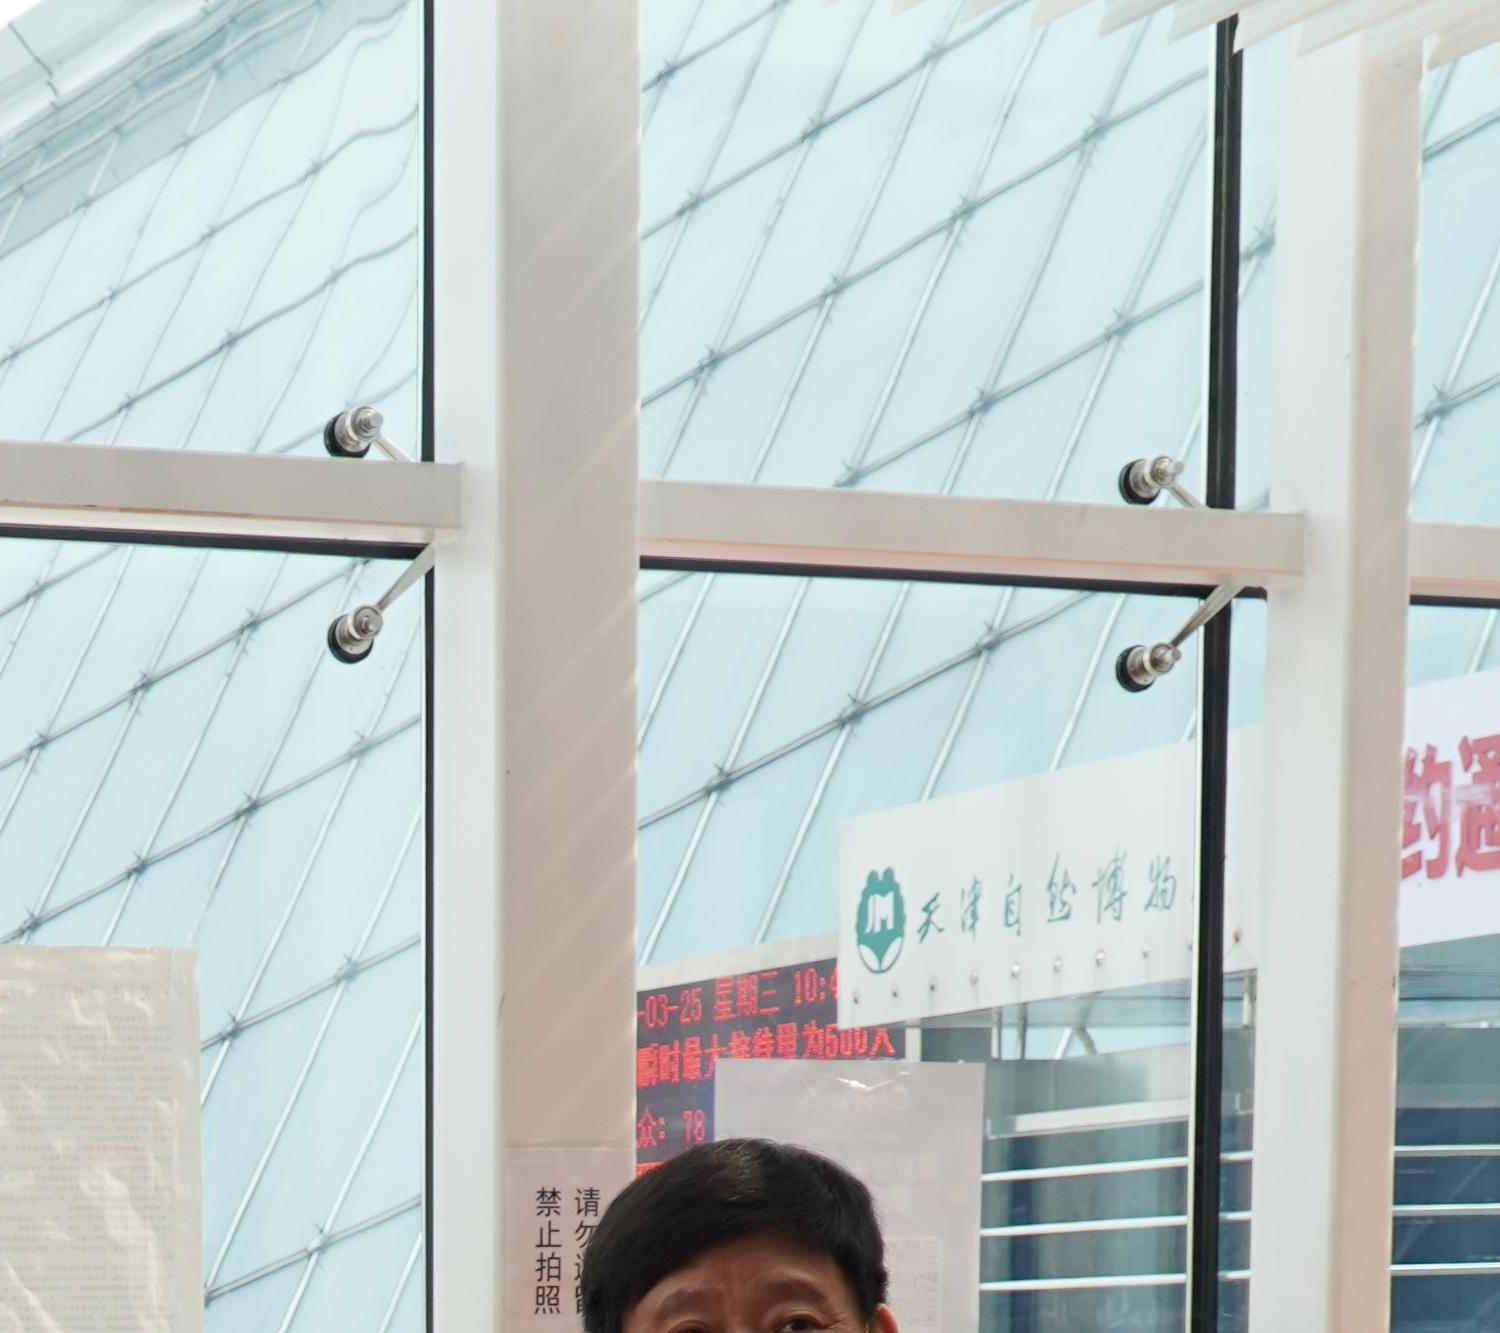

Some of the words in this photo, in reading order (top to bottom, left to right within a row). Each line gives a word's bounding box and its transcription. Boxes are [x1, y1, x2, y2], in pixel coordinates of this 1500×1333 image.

[917, 842, 1180, 945] 天津自然博物
[713, 970, 780, 1022] 星期三
[534, 1187, 562, 1315] 禁止拍照
